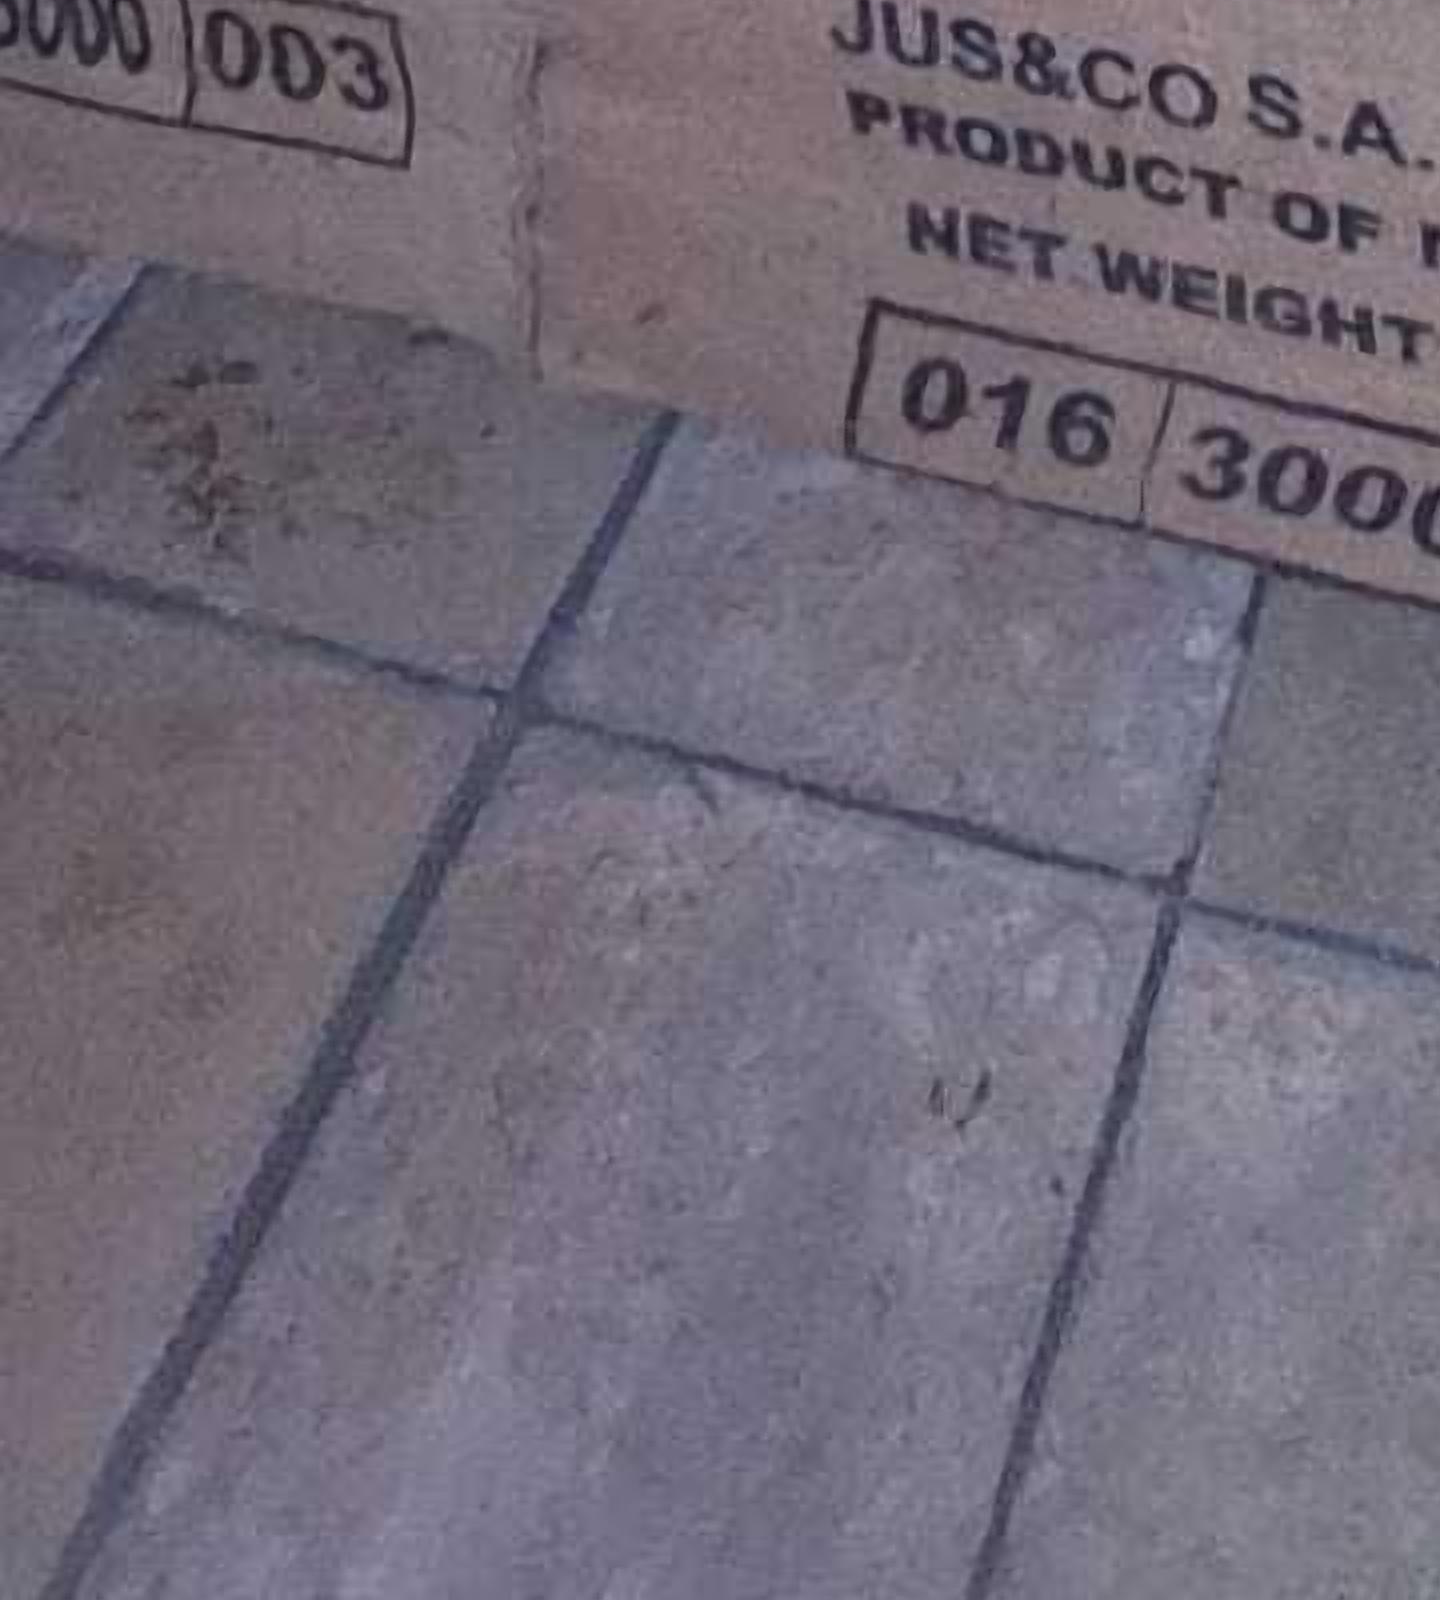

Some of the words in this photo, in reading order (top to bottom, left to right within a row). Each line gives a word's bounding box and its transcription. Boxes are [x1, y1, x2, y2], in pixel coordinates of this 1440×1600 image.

[204, 8, 391, 112] 003
[844, 88, 1241, 221] PRODUCT
[1271, 189, 1383, 254] OF
[1246, 71, 1435, 169] S.A.
[906, 202, 1069, 281] NET
[1093, 241, 1436, 366] WEIGHT
[901, 355, 1117, 468] 016
